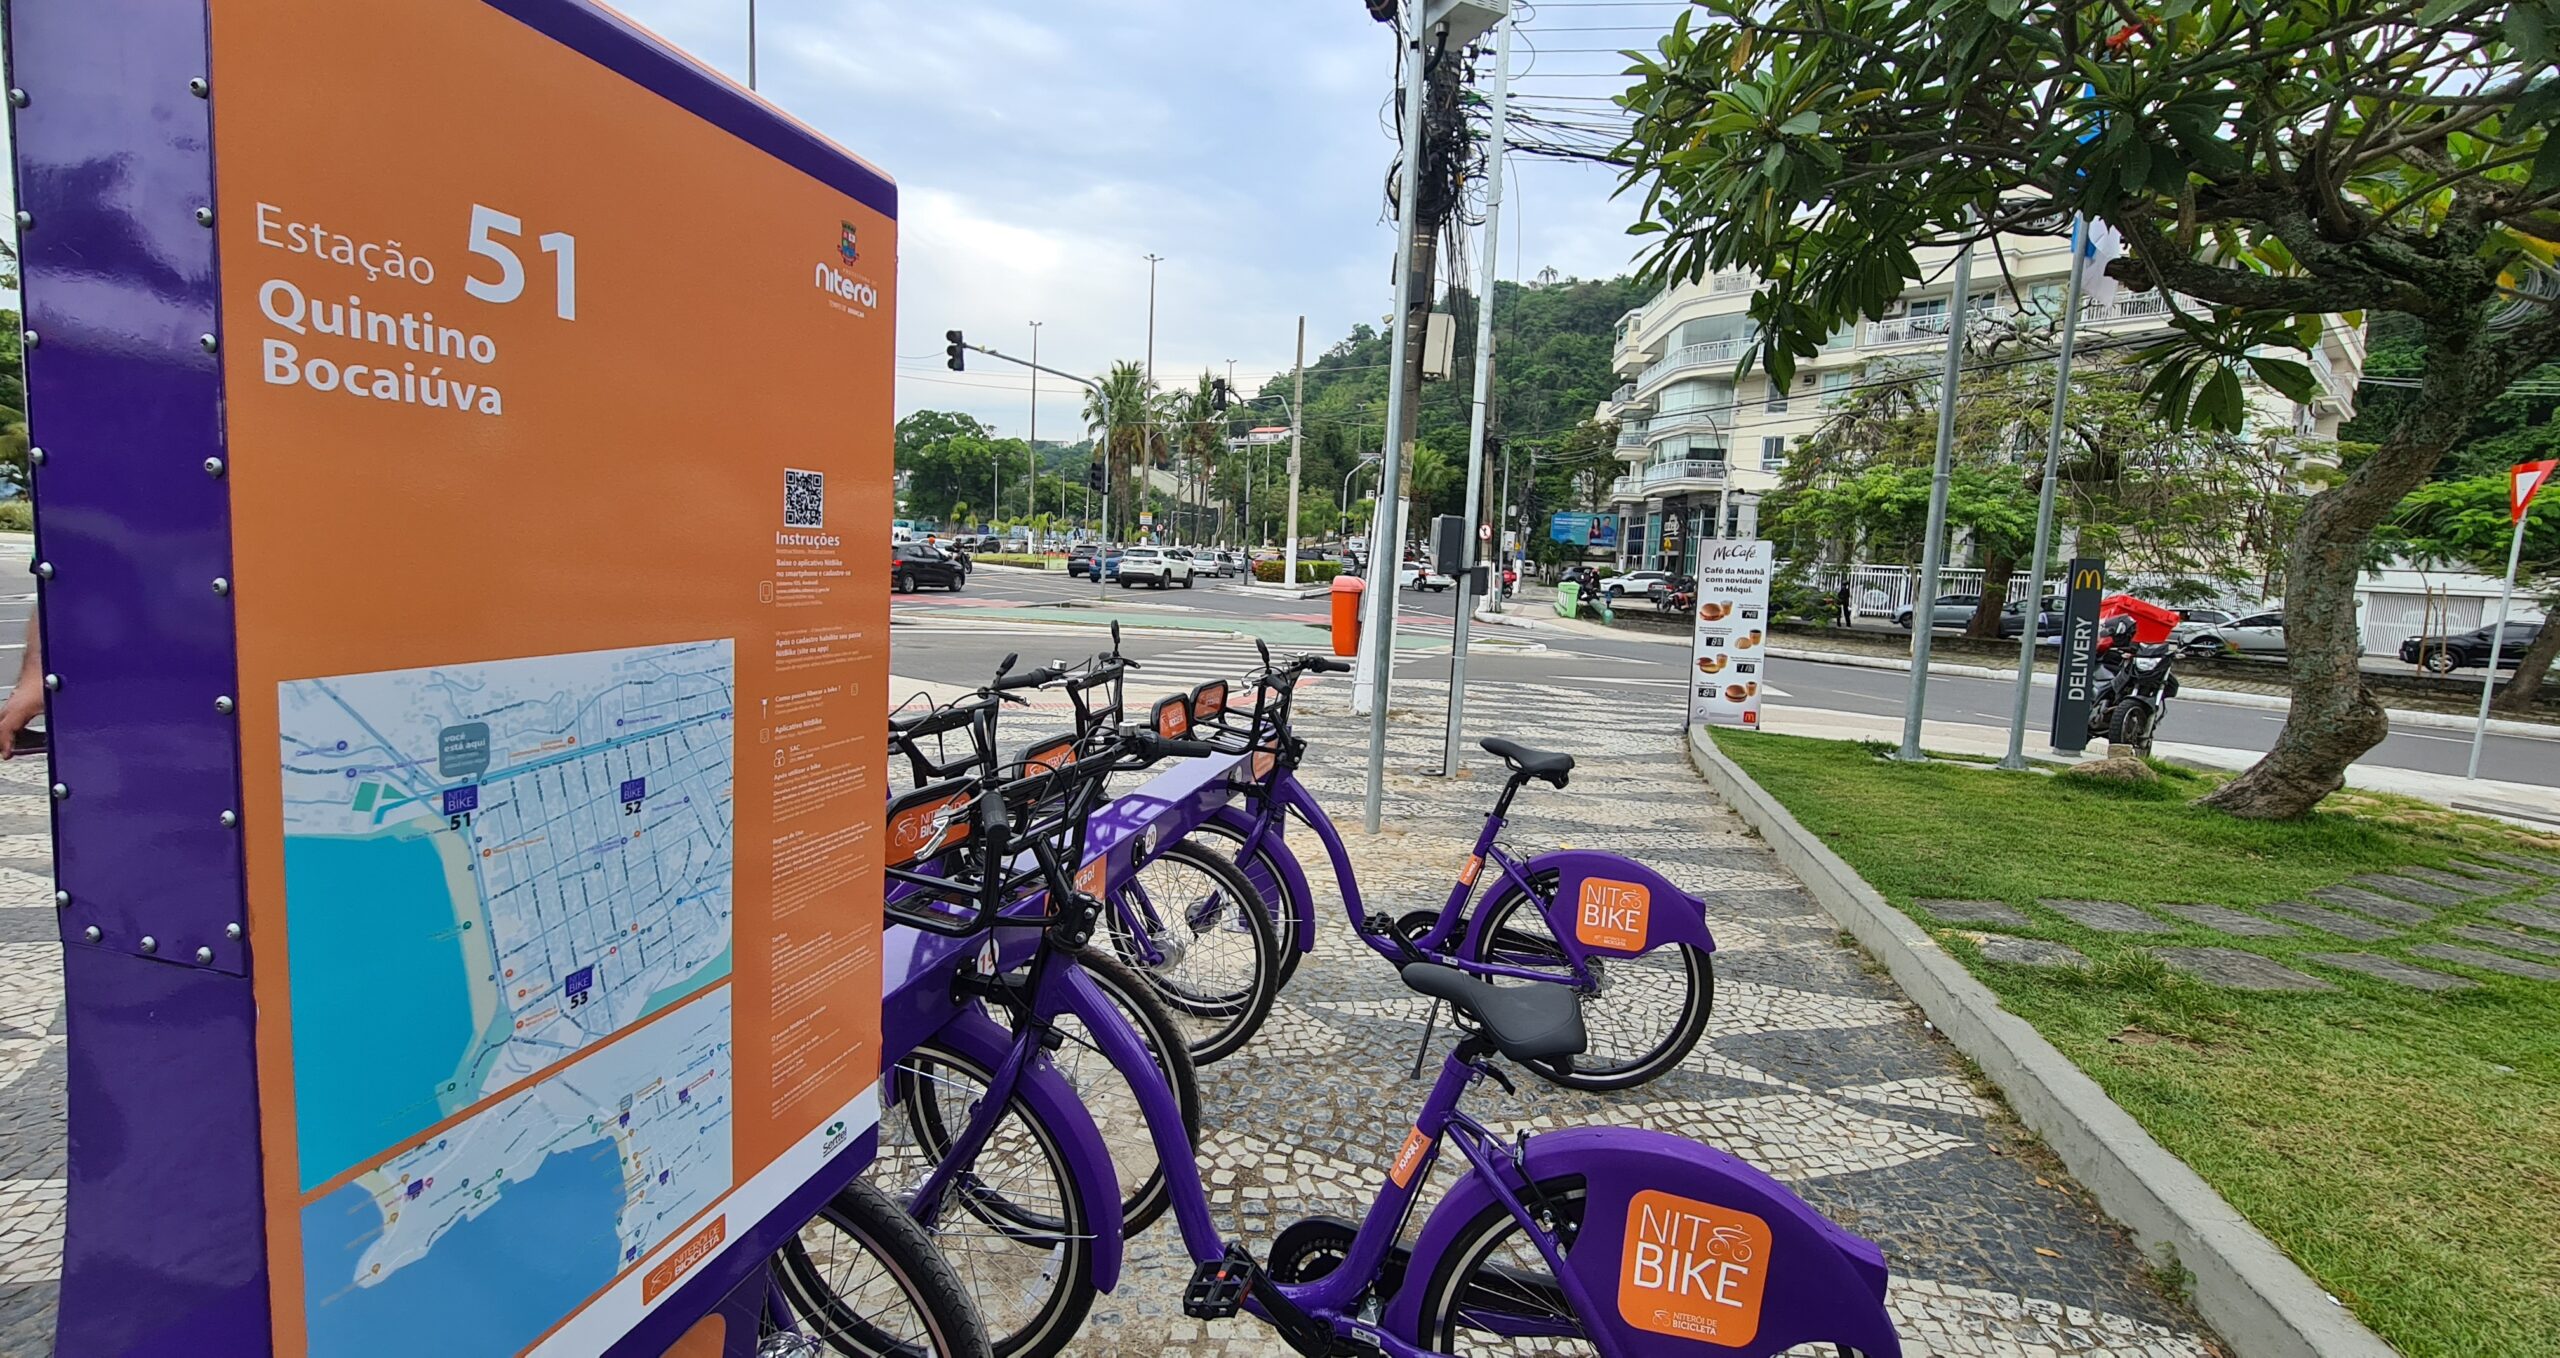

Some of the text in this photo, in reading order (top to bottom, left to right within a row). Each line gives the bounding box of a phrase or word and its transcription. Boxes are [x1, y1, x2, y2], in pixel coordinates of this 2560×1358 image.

[256, 201, 575, 321] Estação 51
[258, 278, 497, 365] Quintino
[262, 338, 503, 416] Bocaiúva
[776, 531, 840, 549] Instruções
[1713, 544, 1757, 562] McCafé
[1704, 566, 1765, 576] Café da Manhã
[1724, 576, 1763, 584] novidade
[2068, 617, 2092, 700] DELIVERY
[444, 732, 466, 742] você
[444, 738, 486, 753] está aqui
[623, 786, 642, 800] BIKE
[448, 795, 474, 812] BIKE
[625, 800, 642, 817] 52
[450, 812, 471, 831] 51
[1586, 884, 1622, 907] NIT
[1583, 903, 1641, 933] BIKE
[569, 976, 590, 993] BIKE
[570, 990, 588, 1010] 53
[1639, 1203, 1711, 1251] NIT
[673, 1223, 721, 1267] NITERÓI DE
[674, 1234, 721, 1278] BICICLETA
[1633, 1240, 1749, 1308] BIKE
[1672, 1319, 1717, 1337] BICICLETA
[1673, 1311, 1718, 1328] NITERÓI DE
